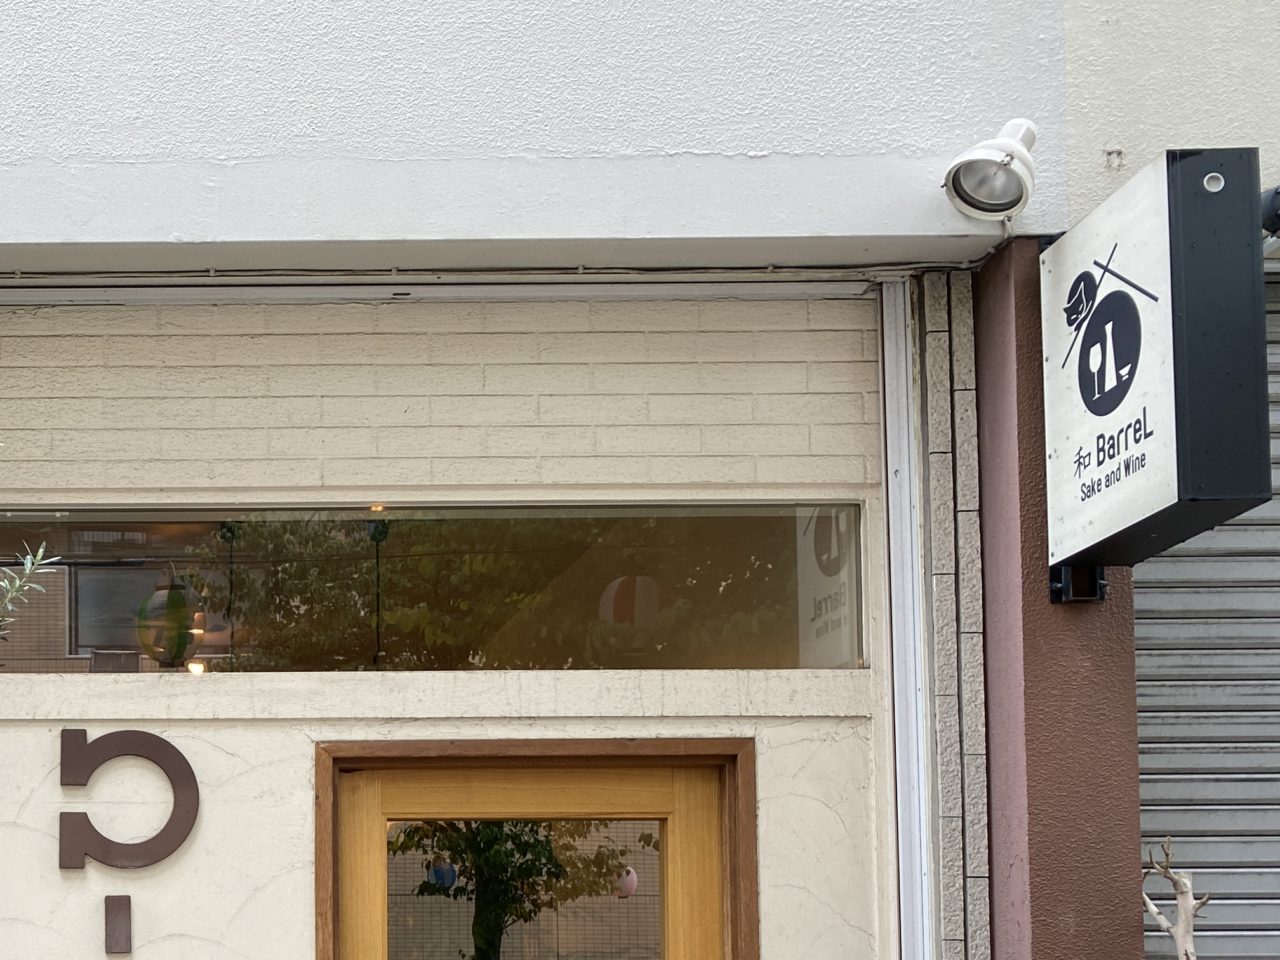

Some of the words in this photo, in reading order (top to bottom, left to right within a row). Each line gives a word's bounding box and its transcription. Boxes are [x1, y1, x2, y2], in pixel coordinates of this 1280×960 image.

[1073, 446, 1091, 479] 和
[1080, 477, 1102, 502] Sake
[1104, 462, 1121, 488] and
[1123, 453, 1146, 478] Wine
